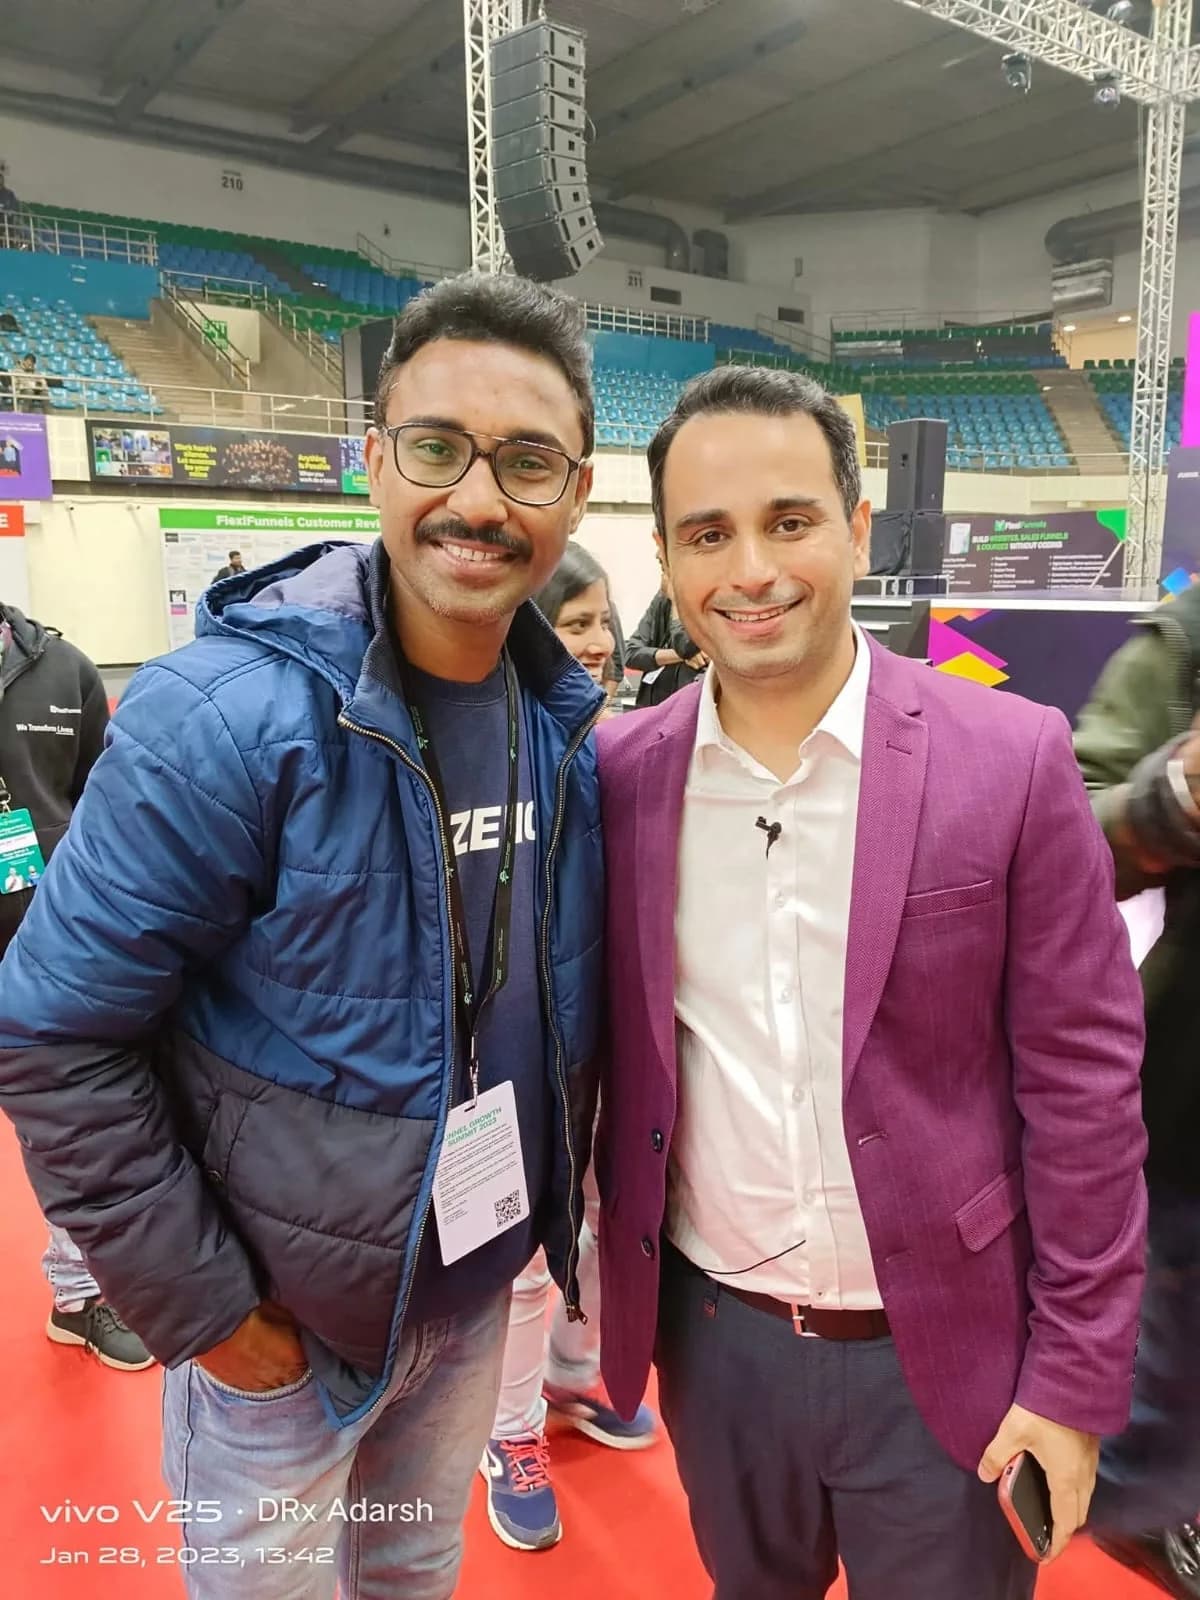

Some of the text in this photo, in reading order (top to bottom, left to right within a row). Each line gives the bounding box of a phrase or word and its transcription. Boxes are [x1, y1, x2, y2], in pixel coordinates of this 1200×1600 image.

[221, 176, 243, 191] 210
[215, 514, 295, 528] FlexiFunnels
[296, 516, 353, 530] Customer
